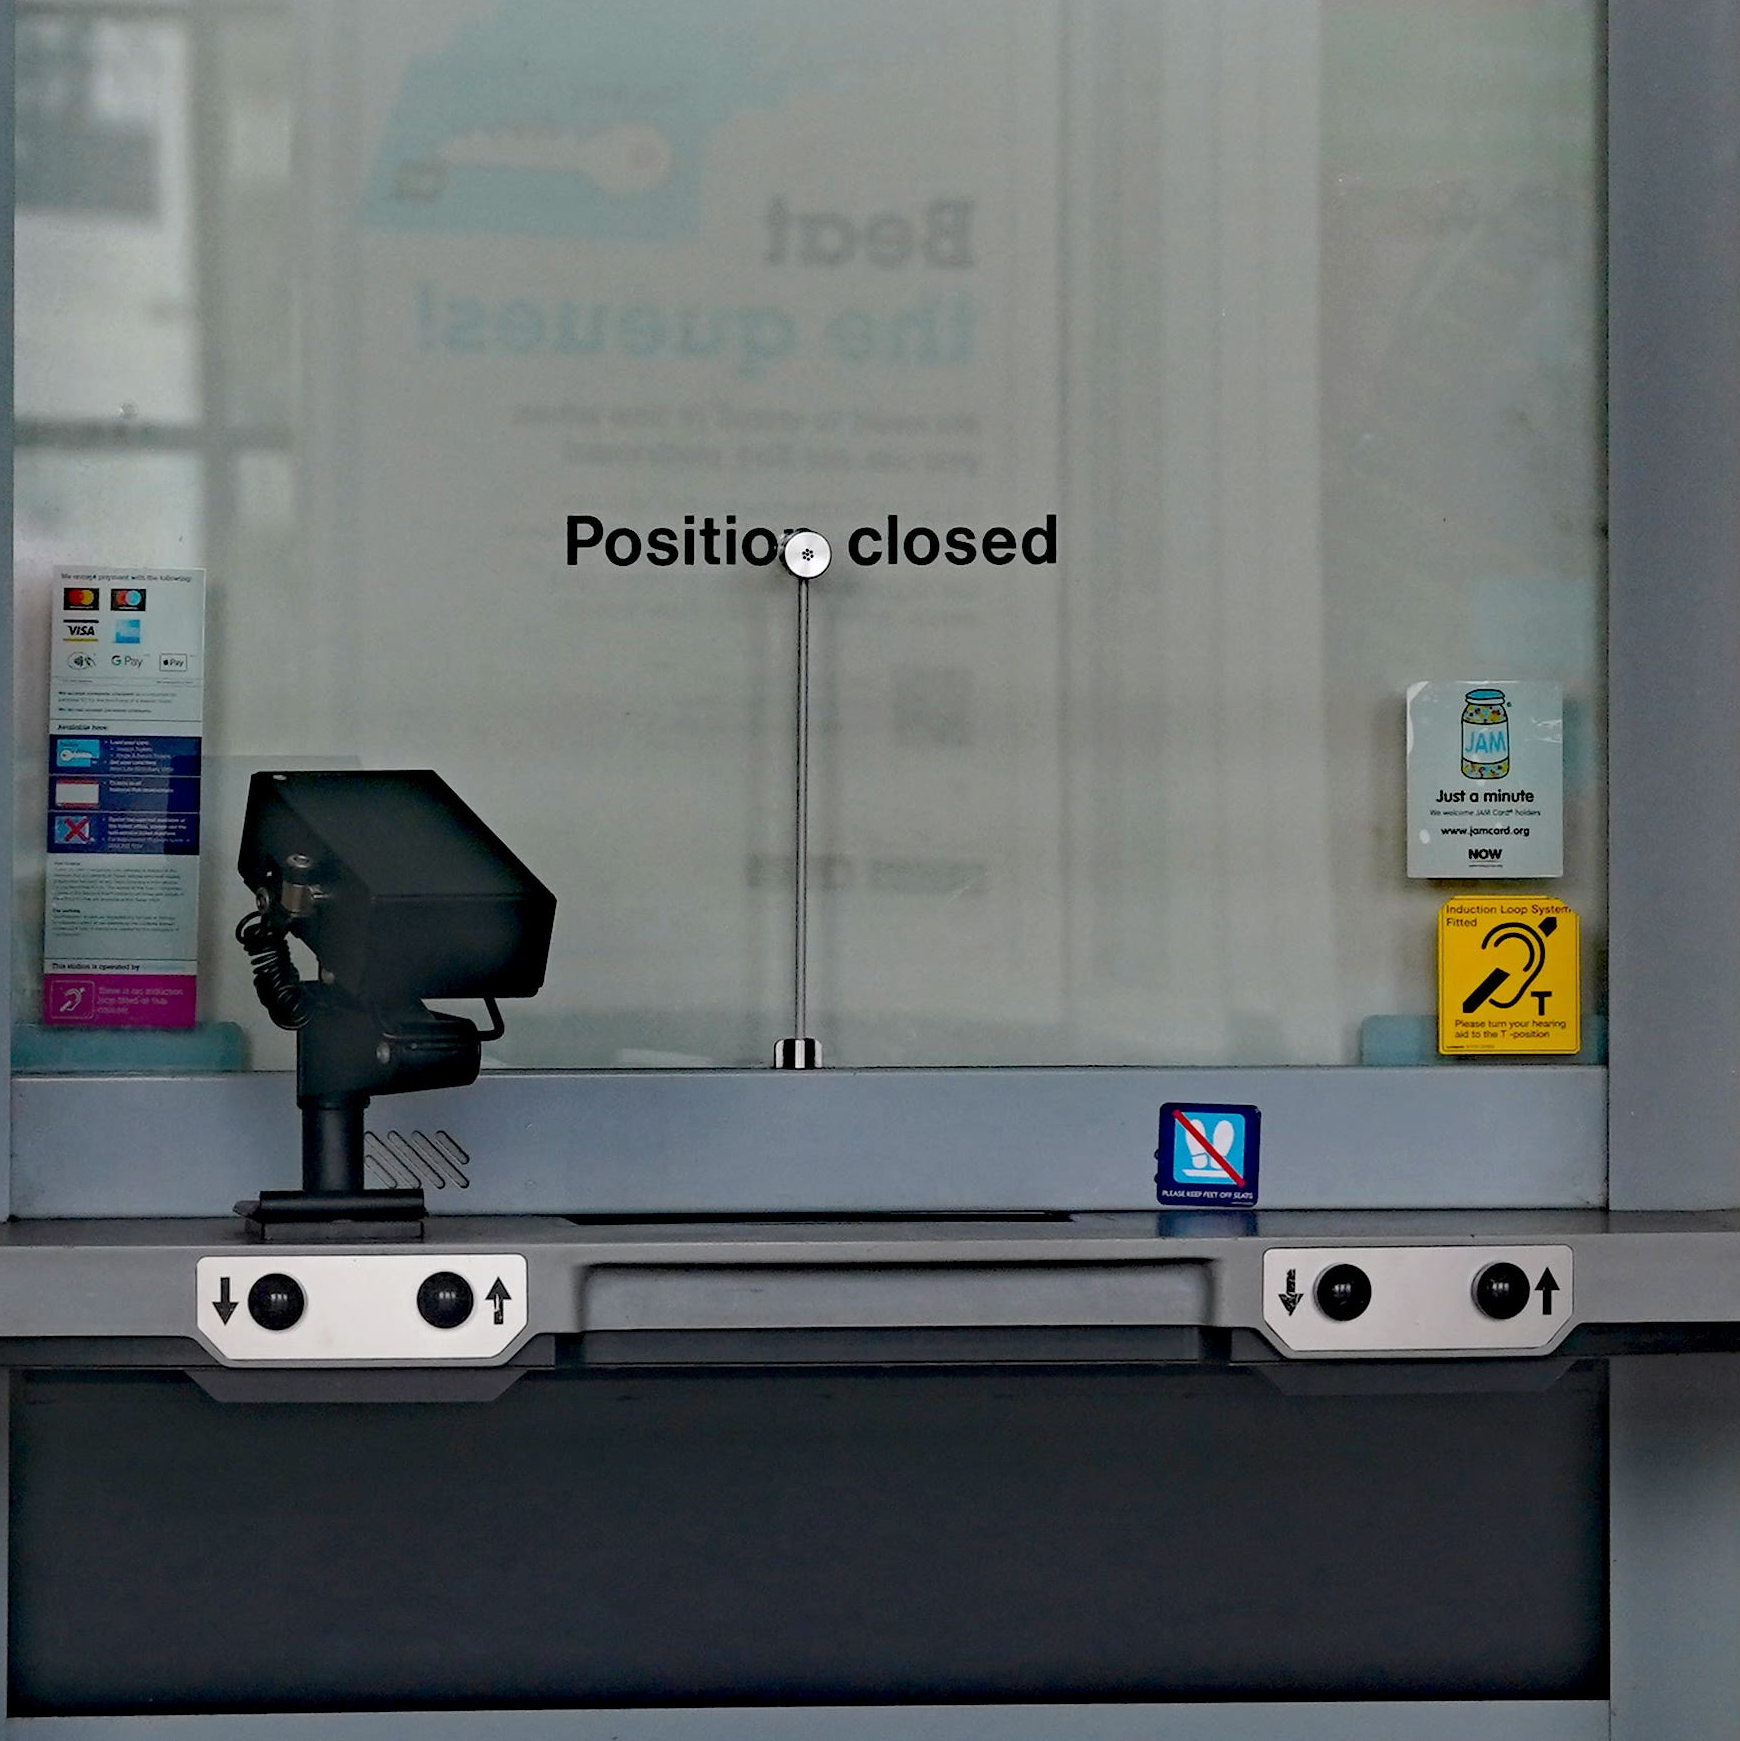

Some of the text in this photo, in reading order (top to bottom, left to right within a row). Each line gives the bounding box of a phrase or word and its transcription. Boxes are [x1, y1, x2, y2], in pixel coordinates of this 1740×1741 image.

[848, 514, 1056, 566] closed
[67, 626, 95, 636] VISA
[124, 656, 143, 668] Pay
[1465, 731, 1507, 753] JAM
[1436, 789, 1534, 803] Just a minute
[1441, 826, 1530, 837] www.jamcard.org
[1468, 848, 1503, 860] NOW
[1446, 905, 1497, 914] Induction
[1500, 905, 1528, 917] Loop
[1446, 918, 1477, 927] Fitted
[1455, 1020, 1566, 1030] Please turn your hearing
[1455, 1030, 1469, 1038] aid
[1471, 1030, 1481, 1038] to
[1483, 1030, 1498, 1038] the
[1162, 1190, 1185, 1198] PLEASE
[1233, 1192, 1253, 1200] SEATS
